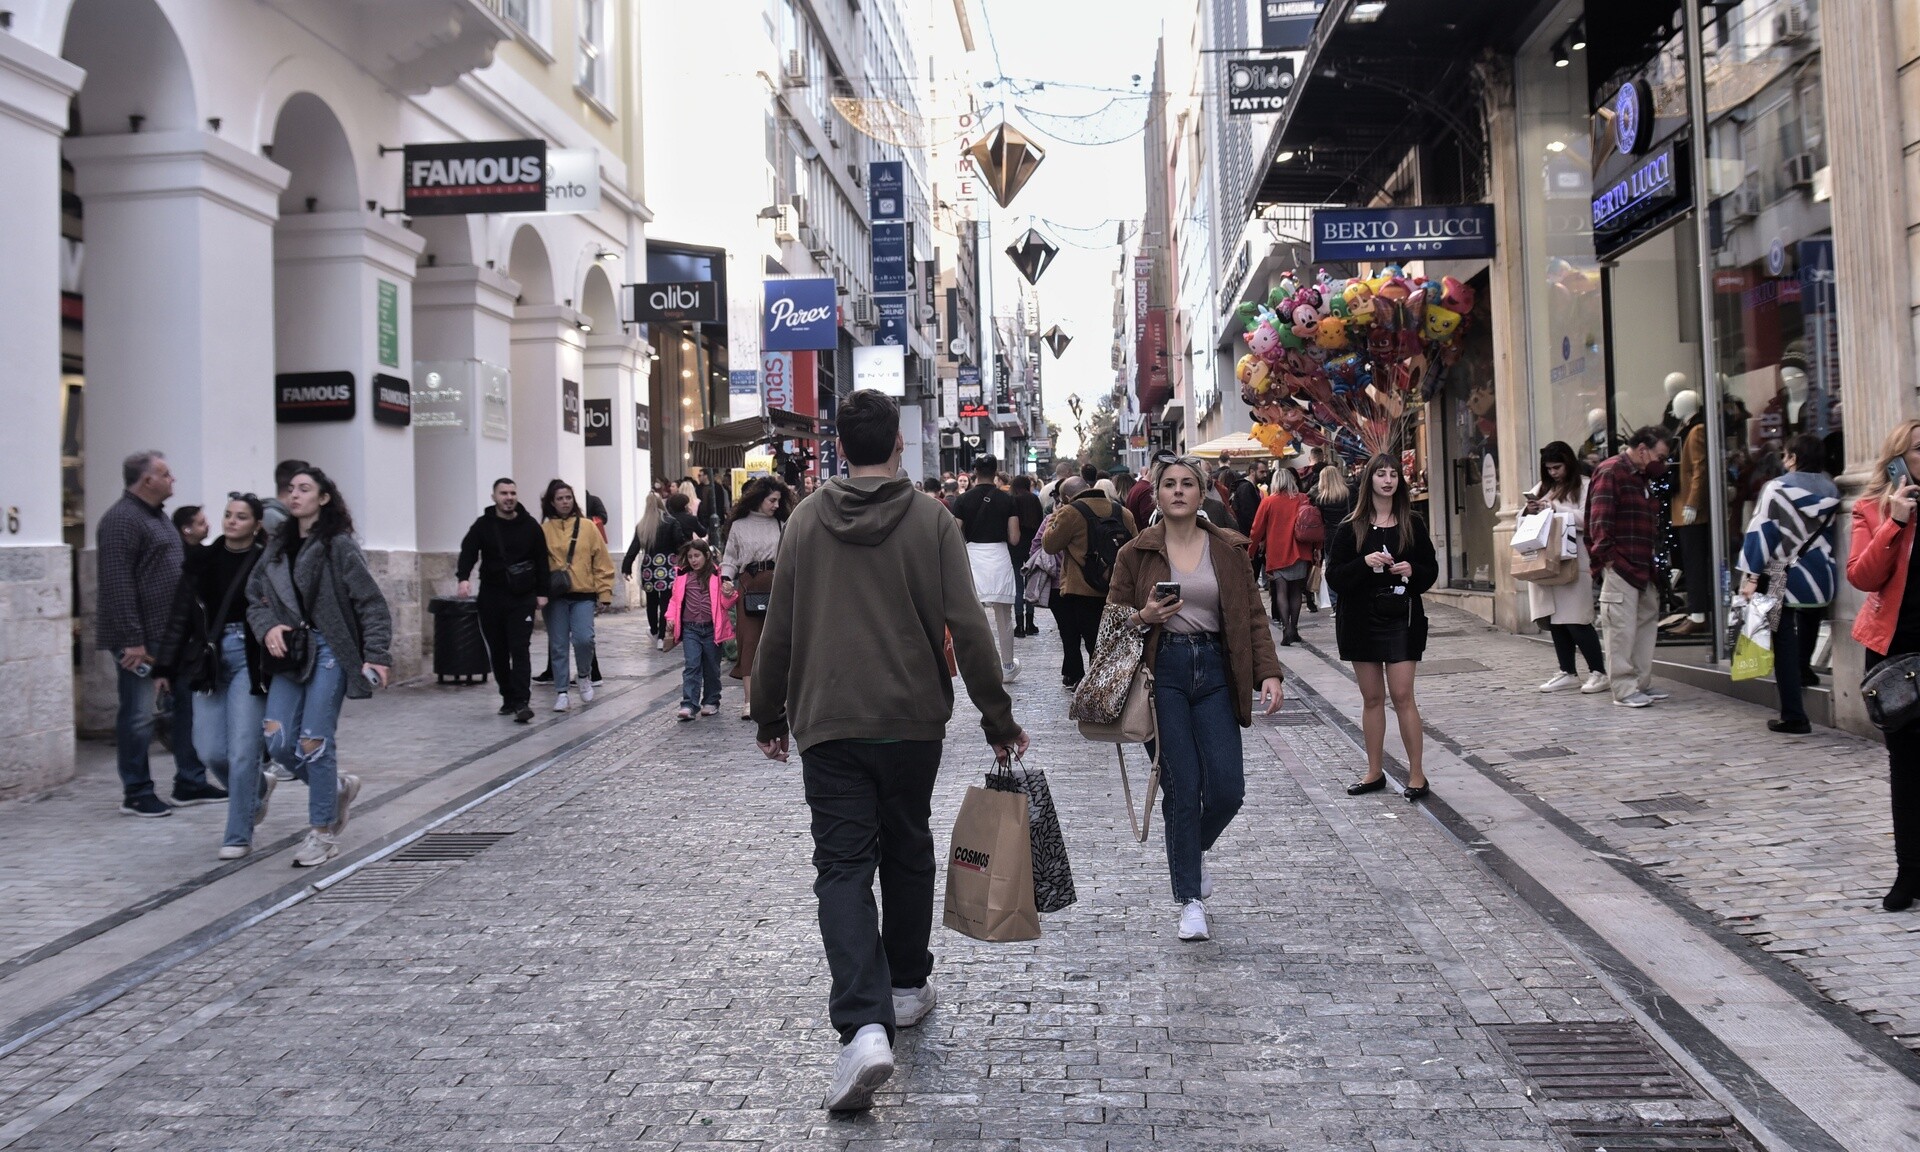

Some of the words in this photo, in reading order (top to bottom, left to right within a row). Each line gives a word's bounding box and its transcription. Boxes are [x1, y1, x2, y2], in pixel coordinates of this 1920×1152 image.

[411, 156, 542, 186] FAMOUS
[1592, 180, 1628, 223] BERTO
[1631, 152, 1670, 196] LUCCI
[1324, 221, 1399, 240] BERTO
[1414, 218, 1482, 238] LUCCI
[1365, 242, 1443, 253] MILANO
[650, 284, 699, 310] alibi
[770, 298, 831, 332] Parex
[282, 384, 350, 402] FAMOUS
[380, 387, 410, 407] FAMOUS
[955, 846, 990, 868] COSMOS
